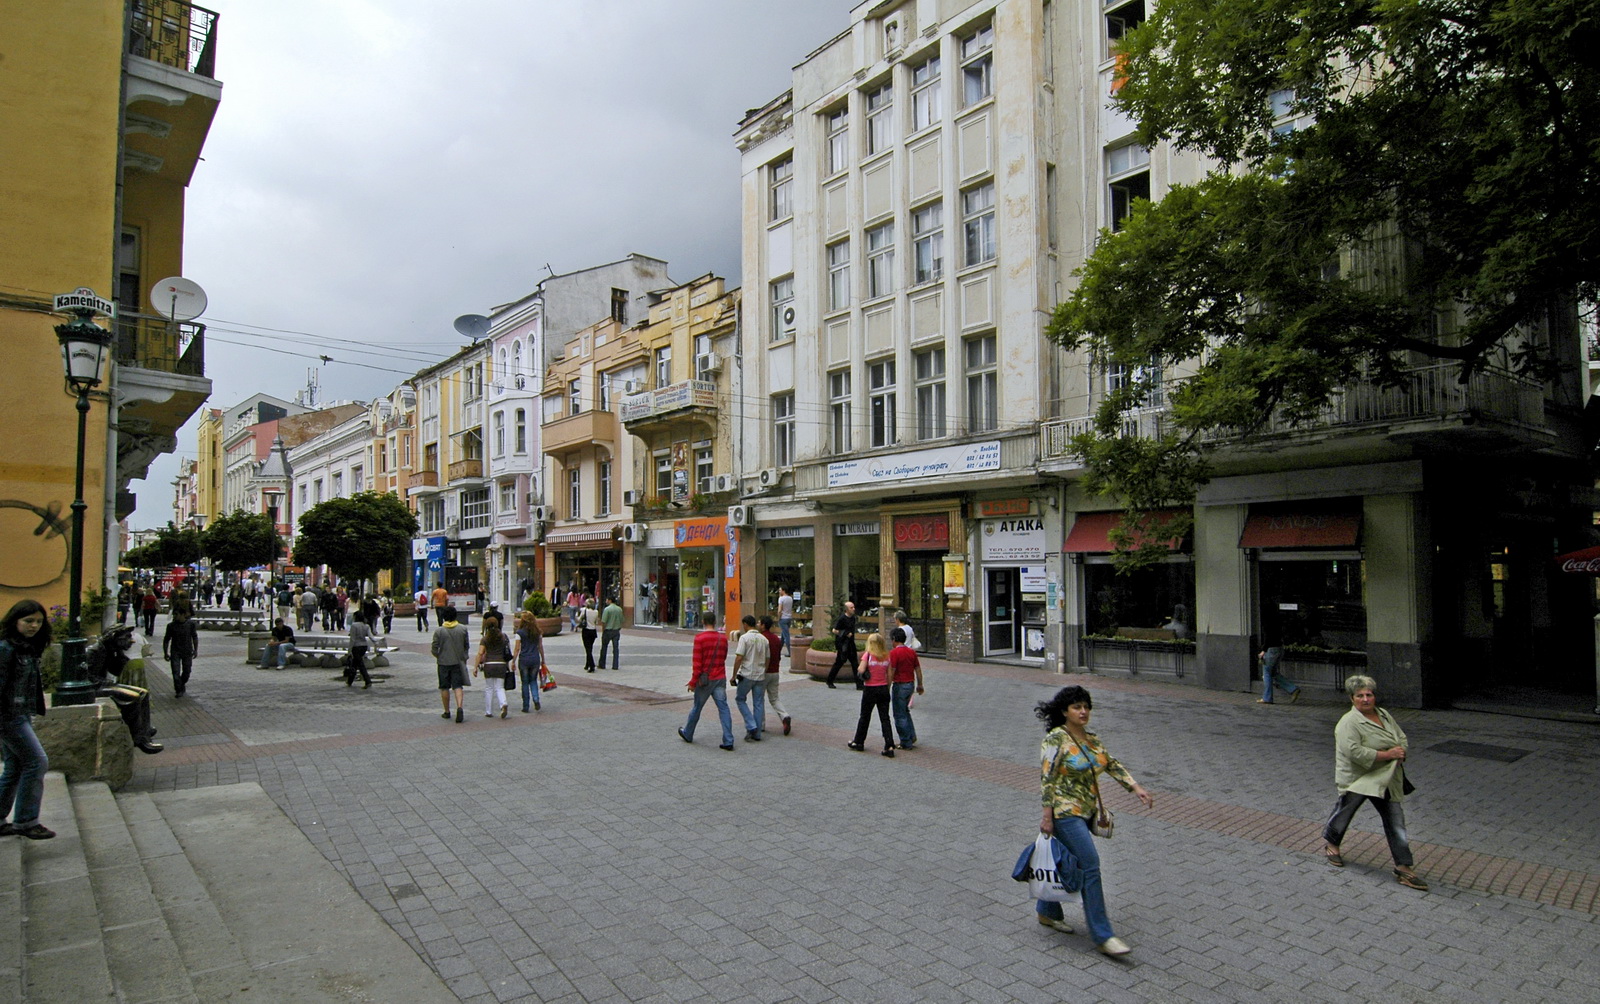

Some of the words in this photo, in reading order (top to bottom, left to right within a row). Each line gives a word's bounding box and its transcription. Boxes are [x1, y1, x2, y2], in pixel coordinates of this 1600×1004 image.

[57, 296, 112, 314] Kamenitza
[693, 381, 715, 391] SORTUR
[847, 523, 874, 534] MURATTI
[1000, 519, 1044, 532] АТАКА
[686, 524, 720, 542] ДЕНДИ
[777, 528, 800, 538] MURATTI
